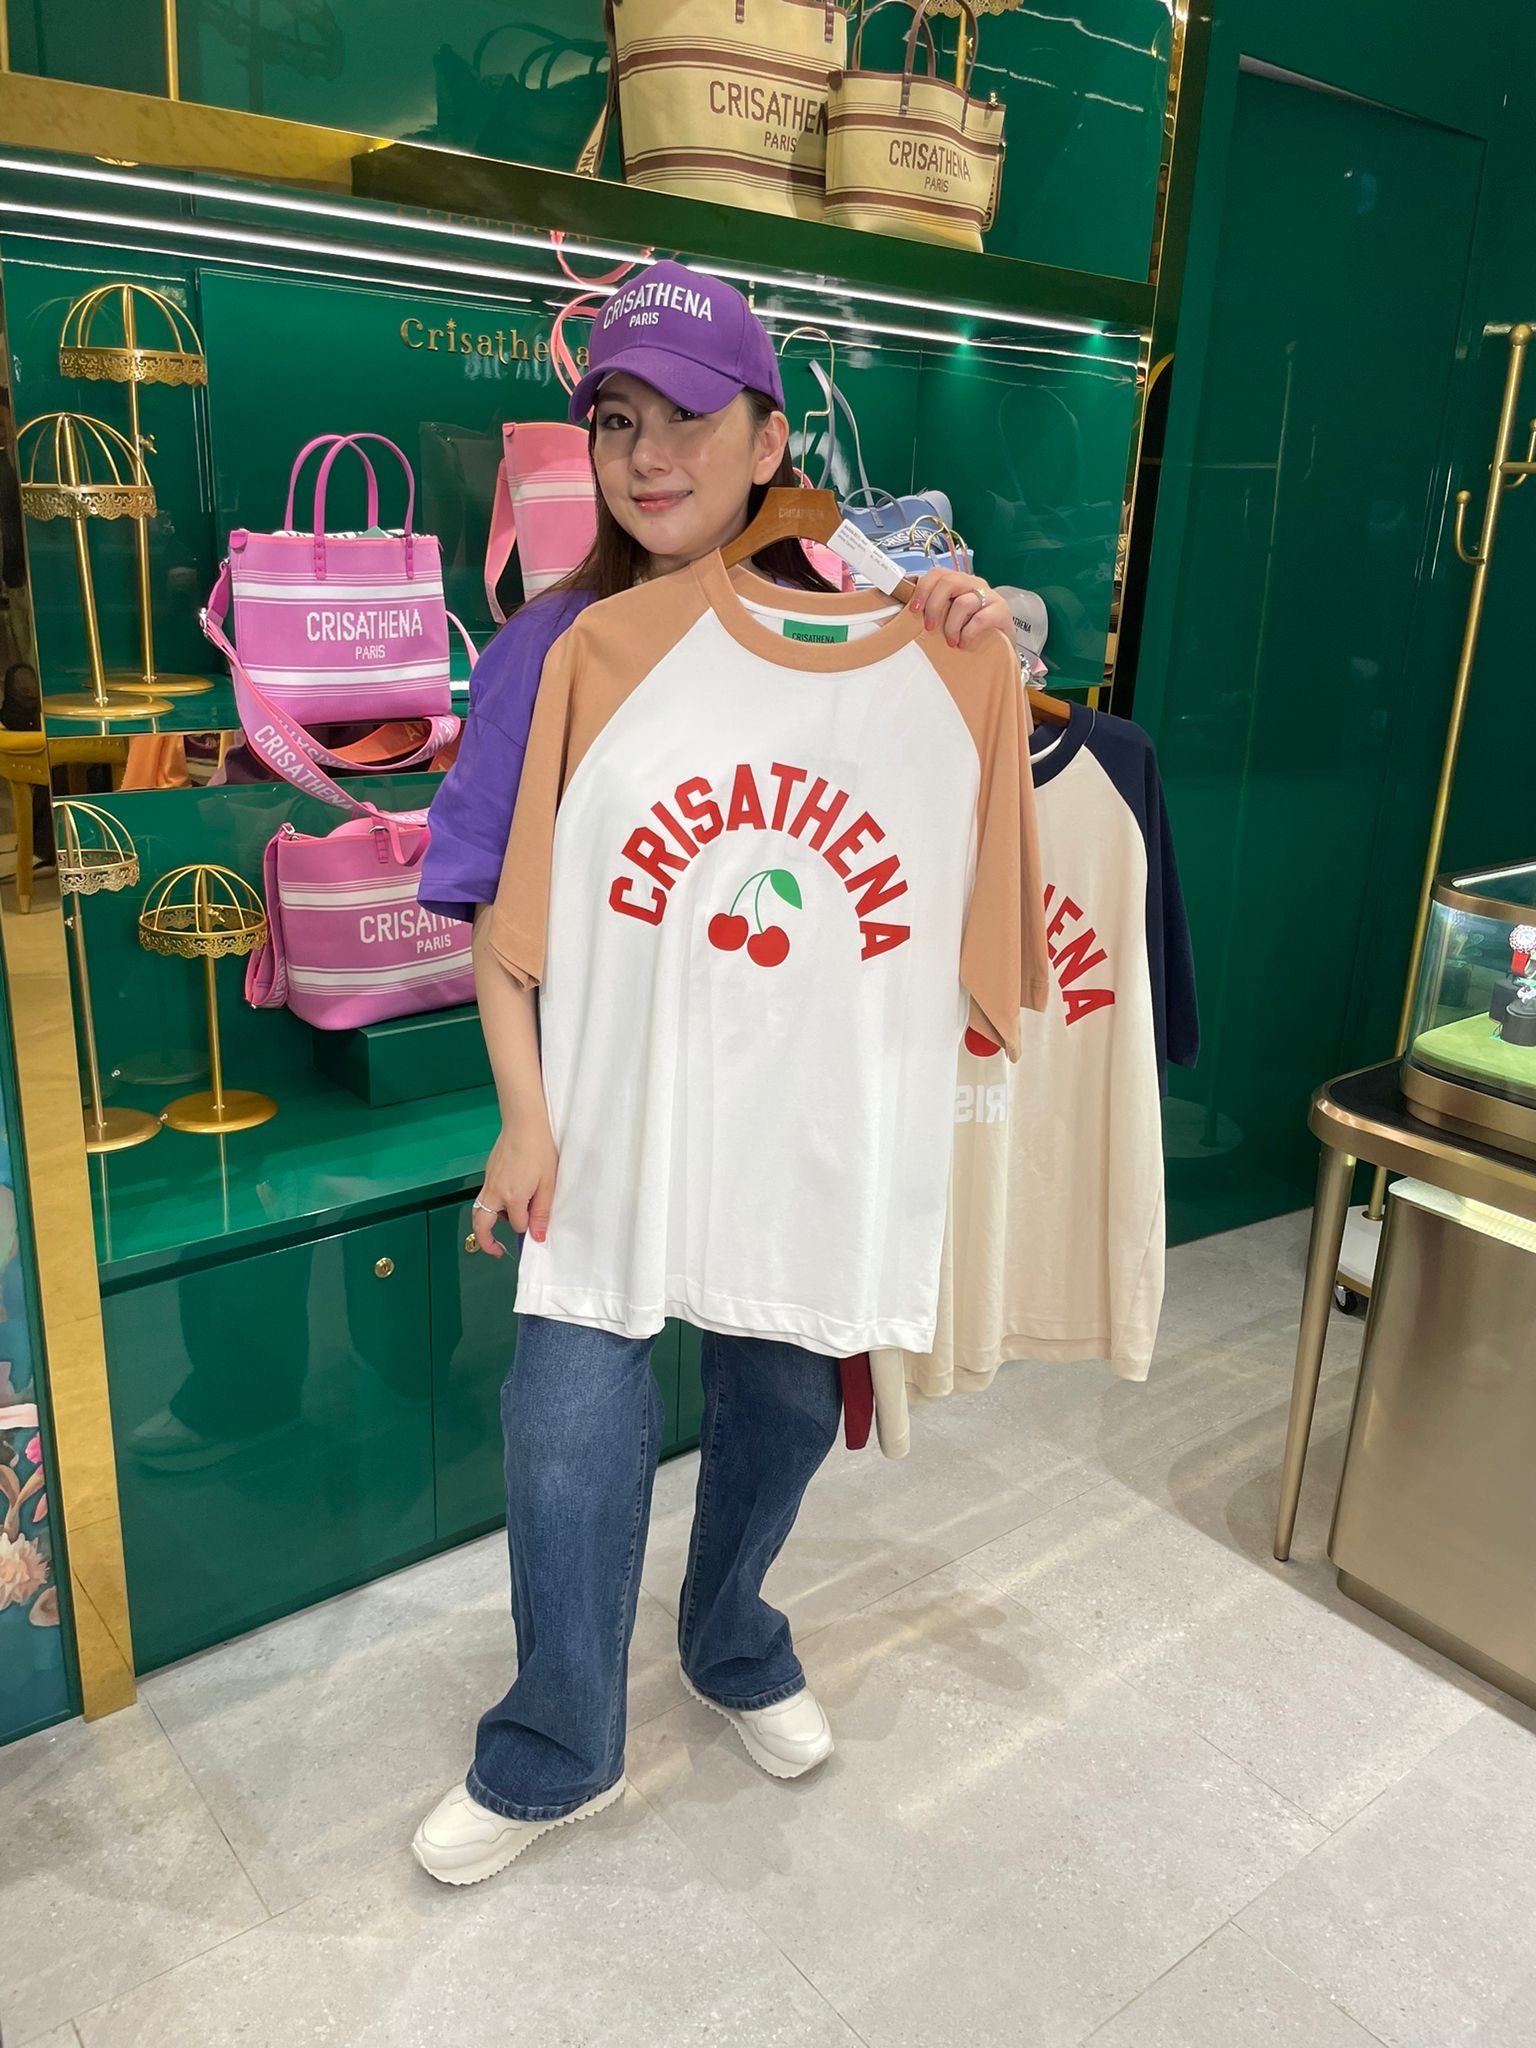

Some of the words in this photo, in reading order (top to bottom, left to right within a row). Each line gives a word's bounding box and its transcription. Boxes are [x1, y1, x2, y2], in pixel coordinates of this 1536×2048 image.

[709, 80, 828, 136] CRISATHEN
[764, 131, 798, 153] PARIS
[889, 139, 972, 182] CRISATHENA
[924, 176, 949, 193] PARIS
[603, 282, 713, 330] CRISATHENA
[629, 312, 660, 328] PARIS
[306, 608, 423, 641] CRISATHENA
[791, 632, 835, 644] CRISATHENA
[355, 645, 386, 660] PARIS
[254, 724, 353, 810] CRISATHENA
[608, 761, 911, 962] CRISATHENA
[416, 934, 452, 954] PARIS
